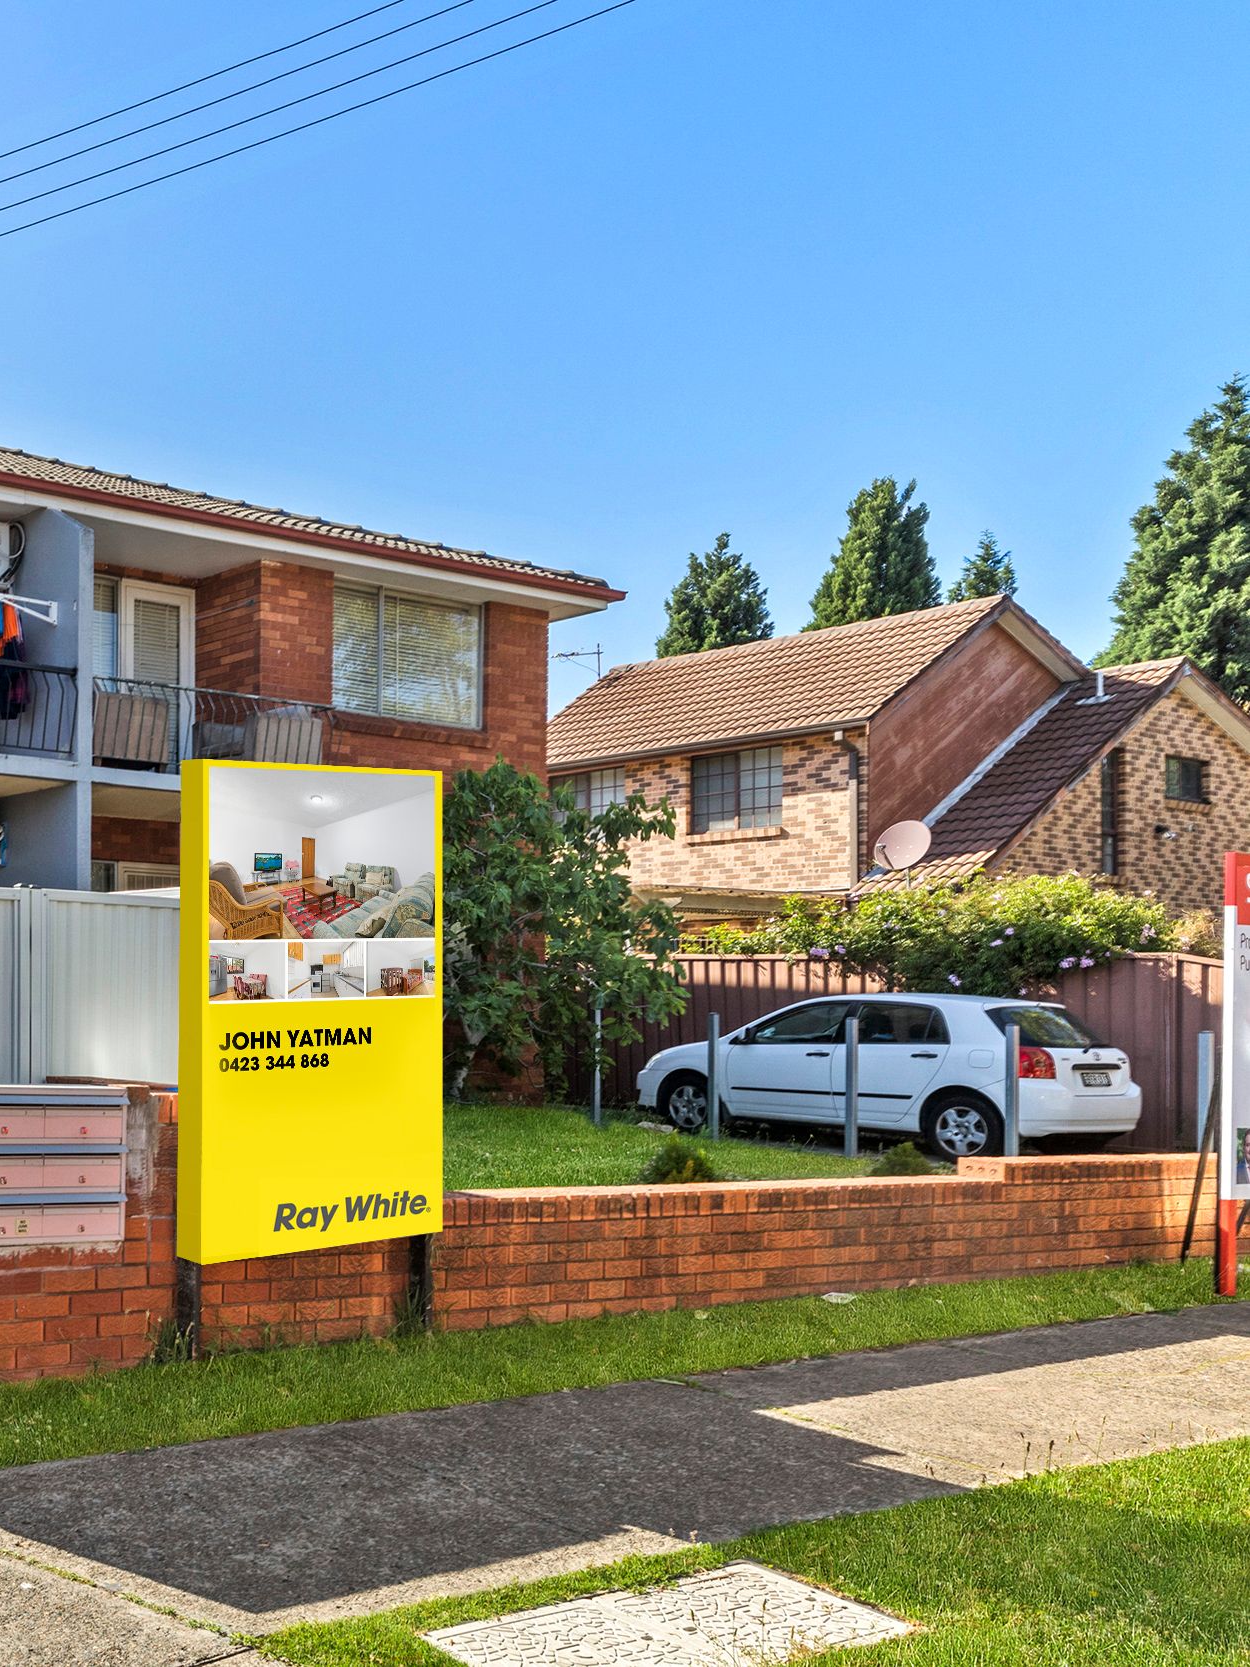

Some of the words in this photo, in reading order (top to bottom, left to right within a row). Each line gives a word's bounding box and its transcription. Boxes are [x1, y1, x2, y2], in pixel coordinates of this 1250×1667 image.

[219, 1031, 281, 1051] JOHN
[286, 1026, 372, 1048] YATMAN
[218, 1056, 260, 1072] 0423
[265, 1054, 295, 1071] 344
[300, 1053, 330, 1069] 868
[273, 1202, 339, 1232] Ray
[345, 1190, 427, 1223] White
